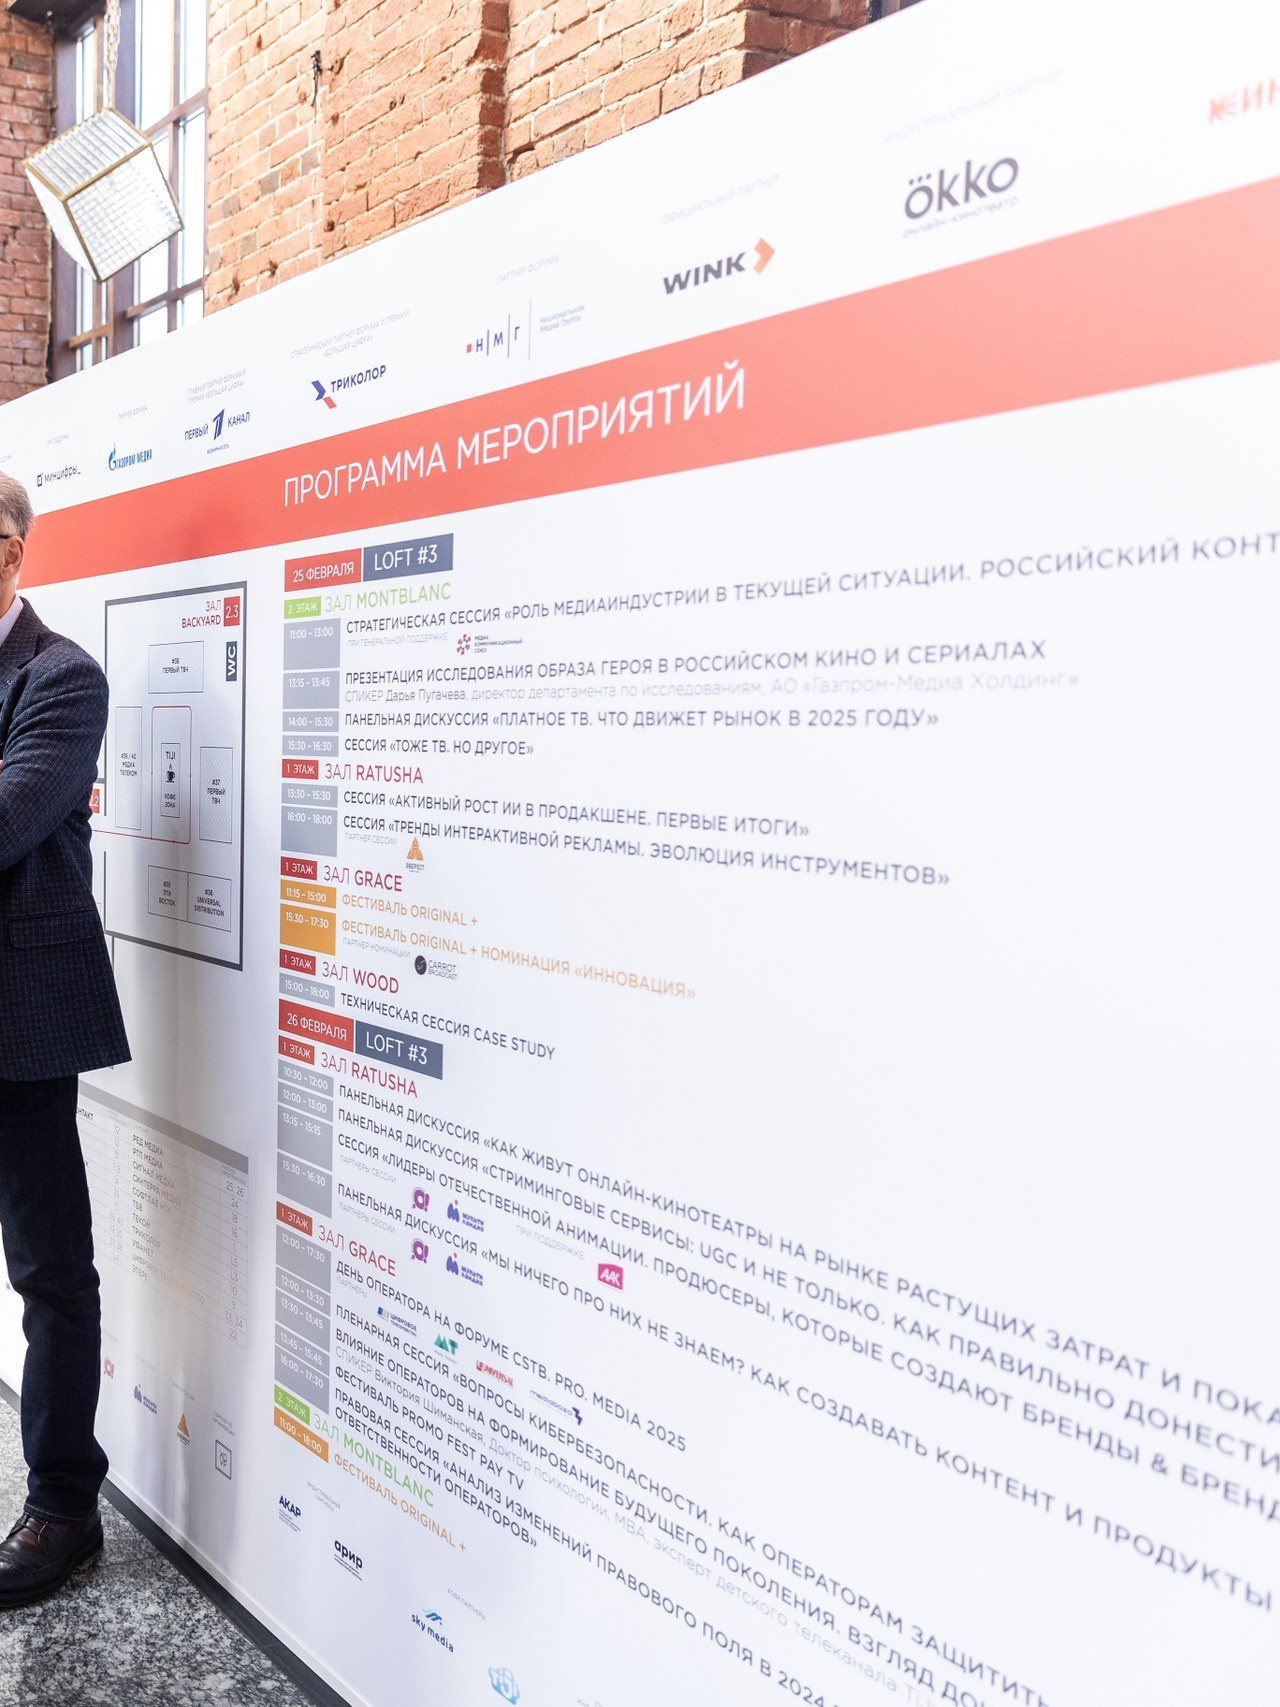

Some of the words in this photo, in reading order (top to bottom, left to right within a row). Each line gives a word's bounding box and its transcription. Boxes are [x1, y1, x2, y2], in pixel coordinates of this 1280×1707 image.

[663, 251, 746, 295] WINK
[331, 365, 386, 393] ТРИКОЛОР
[185, 424, 209, 440] ПЕРВЫЙ
[228, 412, 250, 428] КАНАЛ
[284, 442, 446, 507] ПРОГРАММА
[457, 359, 745, 469] МЕРОПРИЯТИЙ
[293, 569, 304, 583] 25
[306, 561, 355, 582] ФЕВРАЛЯ
[374, 548, 413, 571] LOFT
[417, 544, 438, 565] #3
[314, 626, 334, 638] 13:00
[346, 612, 447, 634] СТРАТЕГИЧЕСКАЯ
[449, 607, 500, 629] СЕССИЯ
[505, 602, 550, 621] «РОЛЬ
[554, 588, 709, 619] МЕДИАИНДУСТРИИ
[734, 572, 832, 601] ТЕКУЩЕЙ
[839, 563, 970, 592] СИТУАЦИИ.
[980, 537, 1180, 579] РОССИЙСКИЙ
[325, 595, 352, 613] ЗАЛ
[356, 582, 451, 609] MONTBLANC
[181, 615, 222, 629] BACKYARD
[206, 600, 221, 612] ЗАЛ
[225, 604, 239, 619] 2.3
[296, 601, 319, 614] ЭТАЖ
[227, 645, 237, 677] WC
[345, 668, 423, 685] ПРЕЗЕНТАЦИЯ
[426, 663, 533, 683] ИССЛЕДОВАНИЯ
[537, 660, 594, 679] ОБРАЗА
[601, 658, 652, 676] ГЕРОЯ
[675, 650, 807, 672] РОССИЙСКОМ
[816, 648, 876, 668] КИНО
[908, 639, 1046, 665] СЕРИАЛАХ
[345, 689, 384, 702] СПИКЕР
[386, 688, 415, 702] Дарья
[418, 687, 469, 703] Пугачева,
[288, 716, 306, 727] 14:00
[313, 716, 333, 727] 15:30
[345, 712, 411, 727] ПАНЕЛЬНАЯ
[414, 712, 488, 728] ДИСКУССИЯ
[492, 711, 565, 726] «ПЛАТНОЕ
[598, 711, 629, 726] ЧТО
[633, 710, 708, 729] ДВИЖЕТ
[713, 710, 782, 727] РЫНОК
[808, 709, 858, 727] 2025
[865, 708, 939, 729] ГОДУ»
[390, 738, 427, 753] «ТОЖЕ
[475, 740, 534, 757] ДРУГОЕ»
[356, 765, 424, 784] RATUSHA
[389, 794, 461, 812] «АКТИВНЫЙ
[465, 799, 498, 815] РОСТ
[539, 804, 651, 826] ПРОДАКШЕНЕ.
[657, 811, 728, 832] ПЕРВЫЕ
[734, 817, 810, 837] ИТОГИ»
[388, 820, 440, 838] «ТРЕНДЫ
[444, 825, 559, 849] ИНТЕРАКТИВНОЙ
[564, 832, 645, 857] РЕКЛАМЫ.
[650, 843, 755, 869] ЭВОЛЮЦИЯ
[761, 854, 950, 885] ИНСТРУМЕНТОВ»
[354, 871, 402, 892] GRACE
[194, 905, 225, 918] DISTRIBUTION
[197, 896, 222, 908] UNIVERSAL
[342, 894, 408, 916] ФЕСТИВАЛЬ
[411, 904, 467, 927] ORIGINAL
[353, 969, 399, 994] WOOD
[428, 960, 457, 974] CARROT
[481, 946, 570, 976] НОМИНАЦИЯ
[575, 961, 696, 999] «ИННОВАЦИЯ»
[284, 979, 303, 992] 15:00
[309, 987, 330, 1000] 18:00
[341, 993, 418, 1024] ТЕХНИЧЕСКАЯ
[422, 1014, 470, 1038] СЕССИЯ
[474, 1027, 507, 1048] CASE
[511, 1037, 556, 1061] STUDY
[287, 1013, 298, 1027] 26
[300, 1018, 347, 1041] ФЕВРАЛЯ
[366, 1031, 402, 1058] LOFT
[351, 1062, 418, 1098] RATUSHA
[339, 1084, 404, 1118] ПАНЕЛЬНАЯ
[407, 1108, 480, 1145] ДИСКУССИЯ
[521, 1147, 573, 1177] ЖИВУТ
[578, 1168, 773, 1249] ОНЛАЙН-КИНОТЕАТРЫ
[814, 1249, 889, 1290] РЫНКЕ
[897, 1277, 1036, 1342] РАСТУЩИХ
[1045, 1328, 1150, 1380] ЗАТРАТ
[349, 1240, 397, 1277] GRACE
[382, 1151, 435, 1183] «ЛИДЕРЫ
[439, 1173, 552, 1228] ОТЕЧЕСТВЕННОЙ
[555, 1219, 648, 1269] АНИМАЦИИ.
[654, 1256, 775, 1321] ПРОДЮСЕРЫ,
[782, 1308, 883, 1361] КОТОРЫЕ
[891, 1351, 1014, 1413] СОЗДАЮТ
[1022, 1404, 1140, 1465] БРЕНДЫ
[482, 1164, 606, 1221] «СТРИМИНГОВЫЕ
[611, 1209, 694, 1253] СЕРВИСЫ:
[701, 1241, 738, 1269] UGC
[794, 1275, 885, 1325] ТОЛЬКО.
[949, 1333, 1115, 1409] ПРАВИЛЬНО
[1124, 1399, 1280, 1474] ДОНЕСТИ
[337, 1261, 363, 1284] ДЕНЬ
[366, 1276, 431, 1319] ОПЕРАТОРА
[513, 1351, 550, 1381] CSTB.
[592, 1394, 642, 1429] MEDIA
[647, 1420, 686, 1452] 2025
[374, 1369, 420, 1404] Виктория
[335, 1366, 399, 1413] ФЕСТИВАЛЬ
[402, 1405, 444, 1440] PROMO
[447, 1432, 477, 1457] FEST
[480, 1452, 504, 1478] PAY
[507, 1470, 525, 1490] TV
[514, 1264, 569, 1297] НИЧЕГО
[674, 1331, 745, 1374] ЗНАЕМ?
[797, 1386, 928, 1457] СОЗДАВАТЬ
[937, 1446, 1055, 1513] КОНТЕНТ
[1094, 1515, 1272, 1612] ПРОДУКТЫ
[335, 1407, 441, 1485] ОТВЕТСТВЕННОСТИ
[445, 1478, 538, 1548] ОПЕРАТОРОВ»
[336, 1306, 400, 1349] ПЛЕНАРНАЯ
[452, 1371, 525, 1421] «ВОПРОСЫ
[529, 1411, 712, 1527] КИБЕРБЕЗОПАСНОСТИ.
[762, 1543, 903, 1634] ОПЕРАТОРАМ
[344, 1432, 434, 1508] MONTBLANC
[279, 1495, 302, 1518] АКАР
[334, 1453, 398, 1506] ФЕСТИВАЛЬ
[400, 1500, 456, 1548] ORIGINAL
[336, 1328, 384, 1365] ВЛИЯНИЕ
[388, 1359, 464, 1413] ОПЕРАТОРОВ
[489, 1418, 610, 1499] ФОРМИРОВАНИЕ
[615, 1490, 708, 1554] БУДУЩЕГО
[714, 1547, 840, 1634] ПОКОЛЕНИЯ.
[848, 1625, 934, 1692] ВЗГЛЯД
[335, 1388, 391, 1434] ПРАВОВАЯ
[443, 1459, 502, 1505] «АНАЛИЗ
[506, 1496, 592, 1564] ИЗМЕНЕНИЙ
[597, 1554, 697, 1628] ПРАВОВОГО
[702, 1621, 754, 1667] ПОЛЯ
[411, 1613, 426, 1632] sky
[427, 1627, 455, 1653] media
